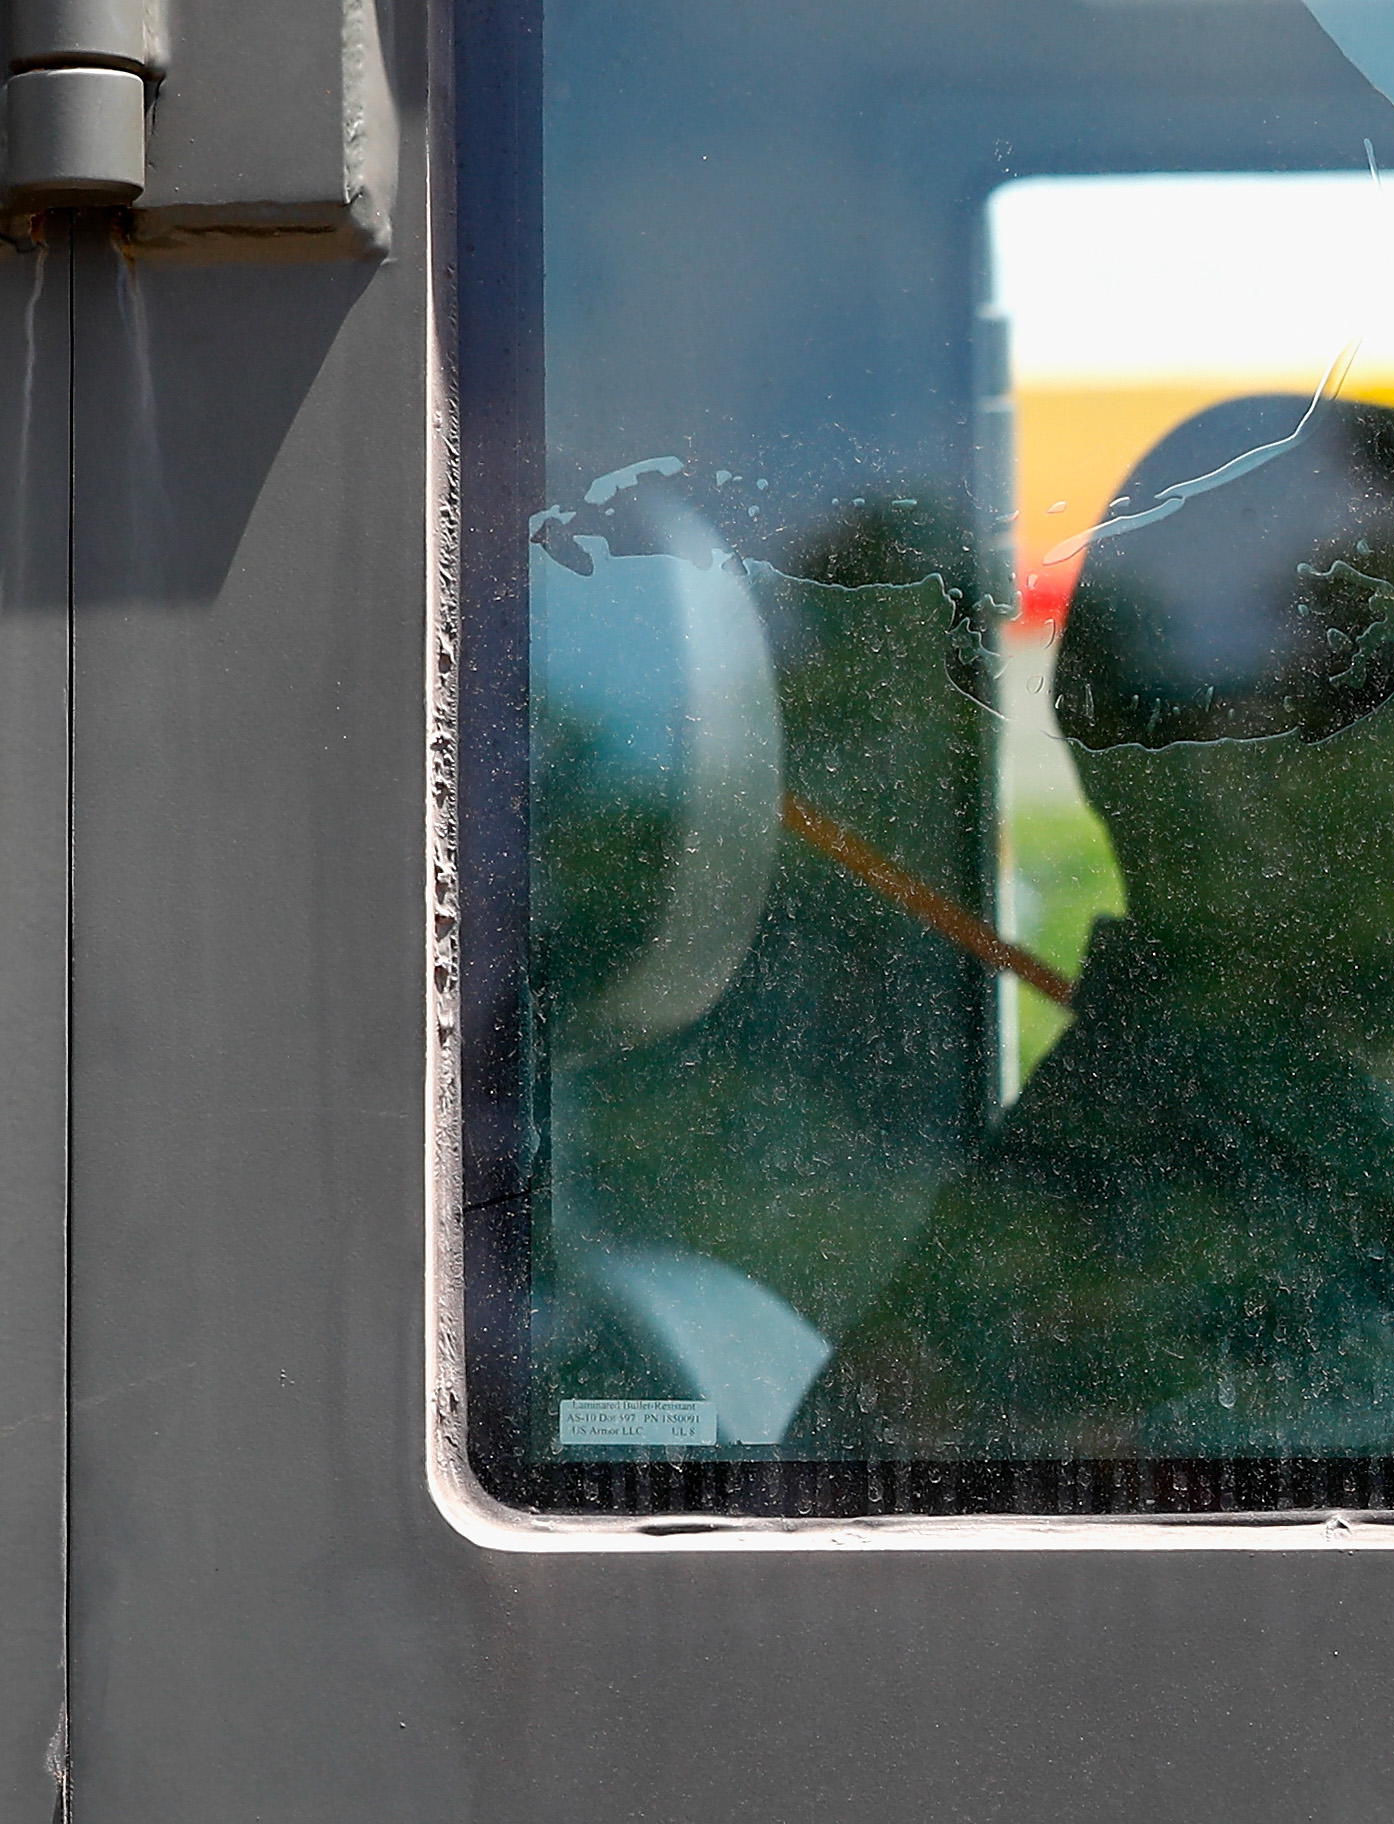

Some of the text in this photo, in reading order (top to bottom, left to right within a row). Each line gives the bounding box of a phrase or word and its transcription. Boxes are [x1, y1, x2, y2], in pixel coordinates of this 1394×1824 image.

[567, 1413, 597, 1422] AS-10
[644, 1413, 659, 1423] PN
[572, 1426, 587, 1435] US
[589, 1426, 620, 1435] Armor
[622, 1426, 644, 1436] LLC
